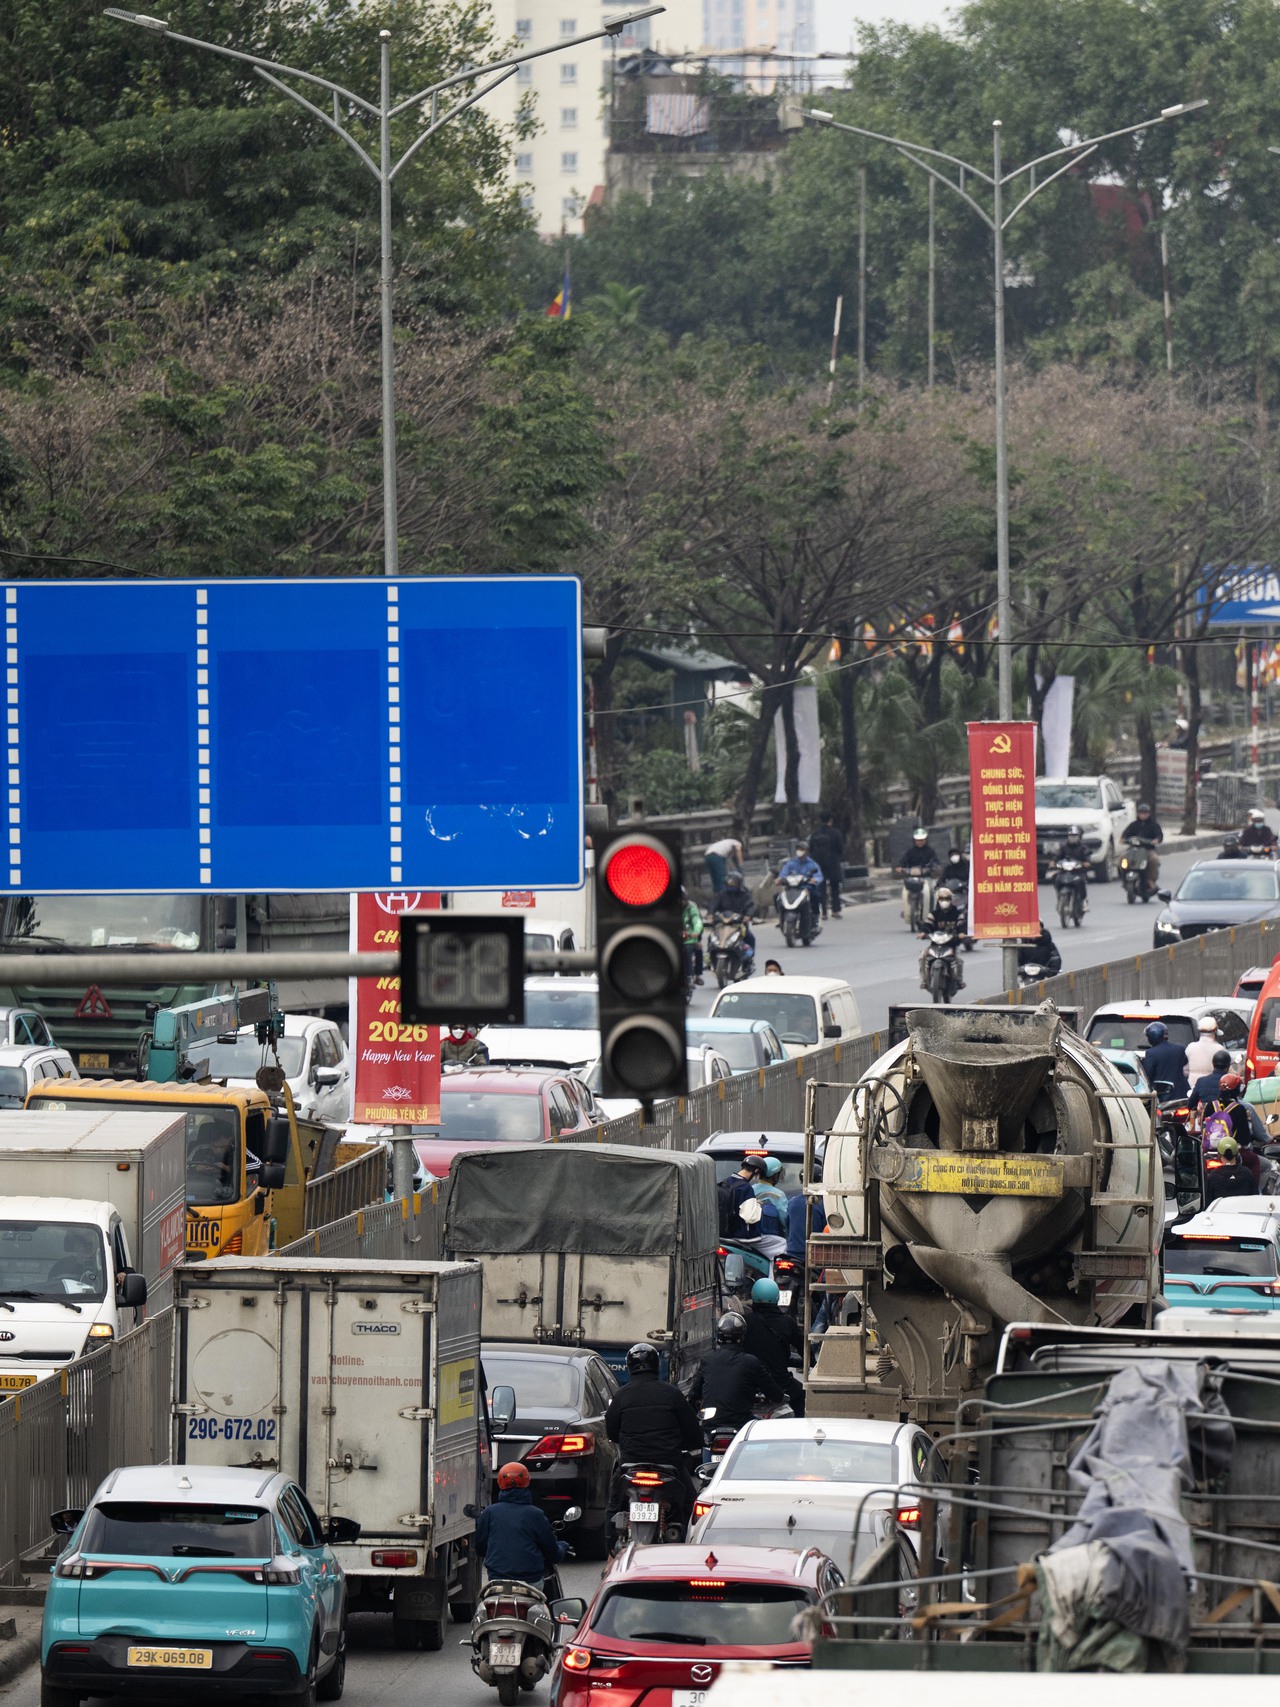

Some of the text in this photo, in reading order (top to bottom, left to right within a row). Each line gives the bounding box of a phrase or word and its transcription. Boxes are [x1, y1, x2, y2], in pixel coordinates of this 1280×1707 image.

[981, 768, 1006, 779] CHUNG
[1004, 782, 1024, 795] LÒNG
[985, 799, 1022, 813] THỰC HIỆN
[1011, 816, 1023, 829] LỢI
[979, 831, 1031, 845] CÁC MỤC TIÊU
[984, 848, 1003, 860] PHÁT
[987, 863, 1024, 876] ĐẤT NƯỚC
[994, 880, 1012, 892] NĂM
[1013, 881, 1034, 892] 2030!
[368, 1021, 428, 1043] 2026
[361, 1049, 436, 1065] Happy New Year
[365, 1105, 428, 1121] PHƯỜNG YÊN SỞ
[356, 1324, 398, 1333] THACO
[330, 1354, 364, 1367] Hotline:
[188, 1417, 276, 1441] 29C-672.02
[631, 1512, 658, 1522] 039.23
[134, 1650, 205, 1665] 29K-069.08
[493, 1654, 516, 1665] 7743
